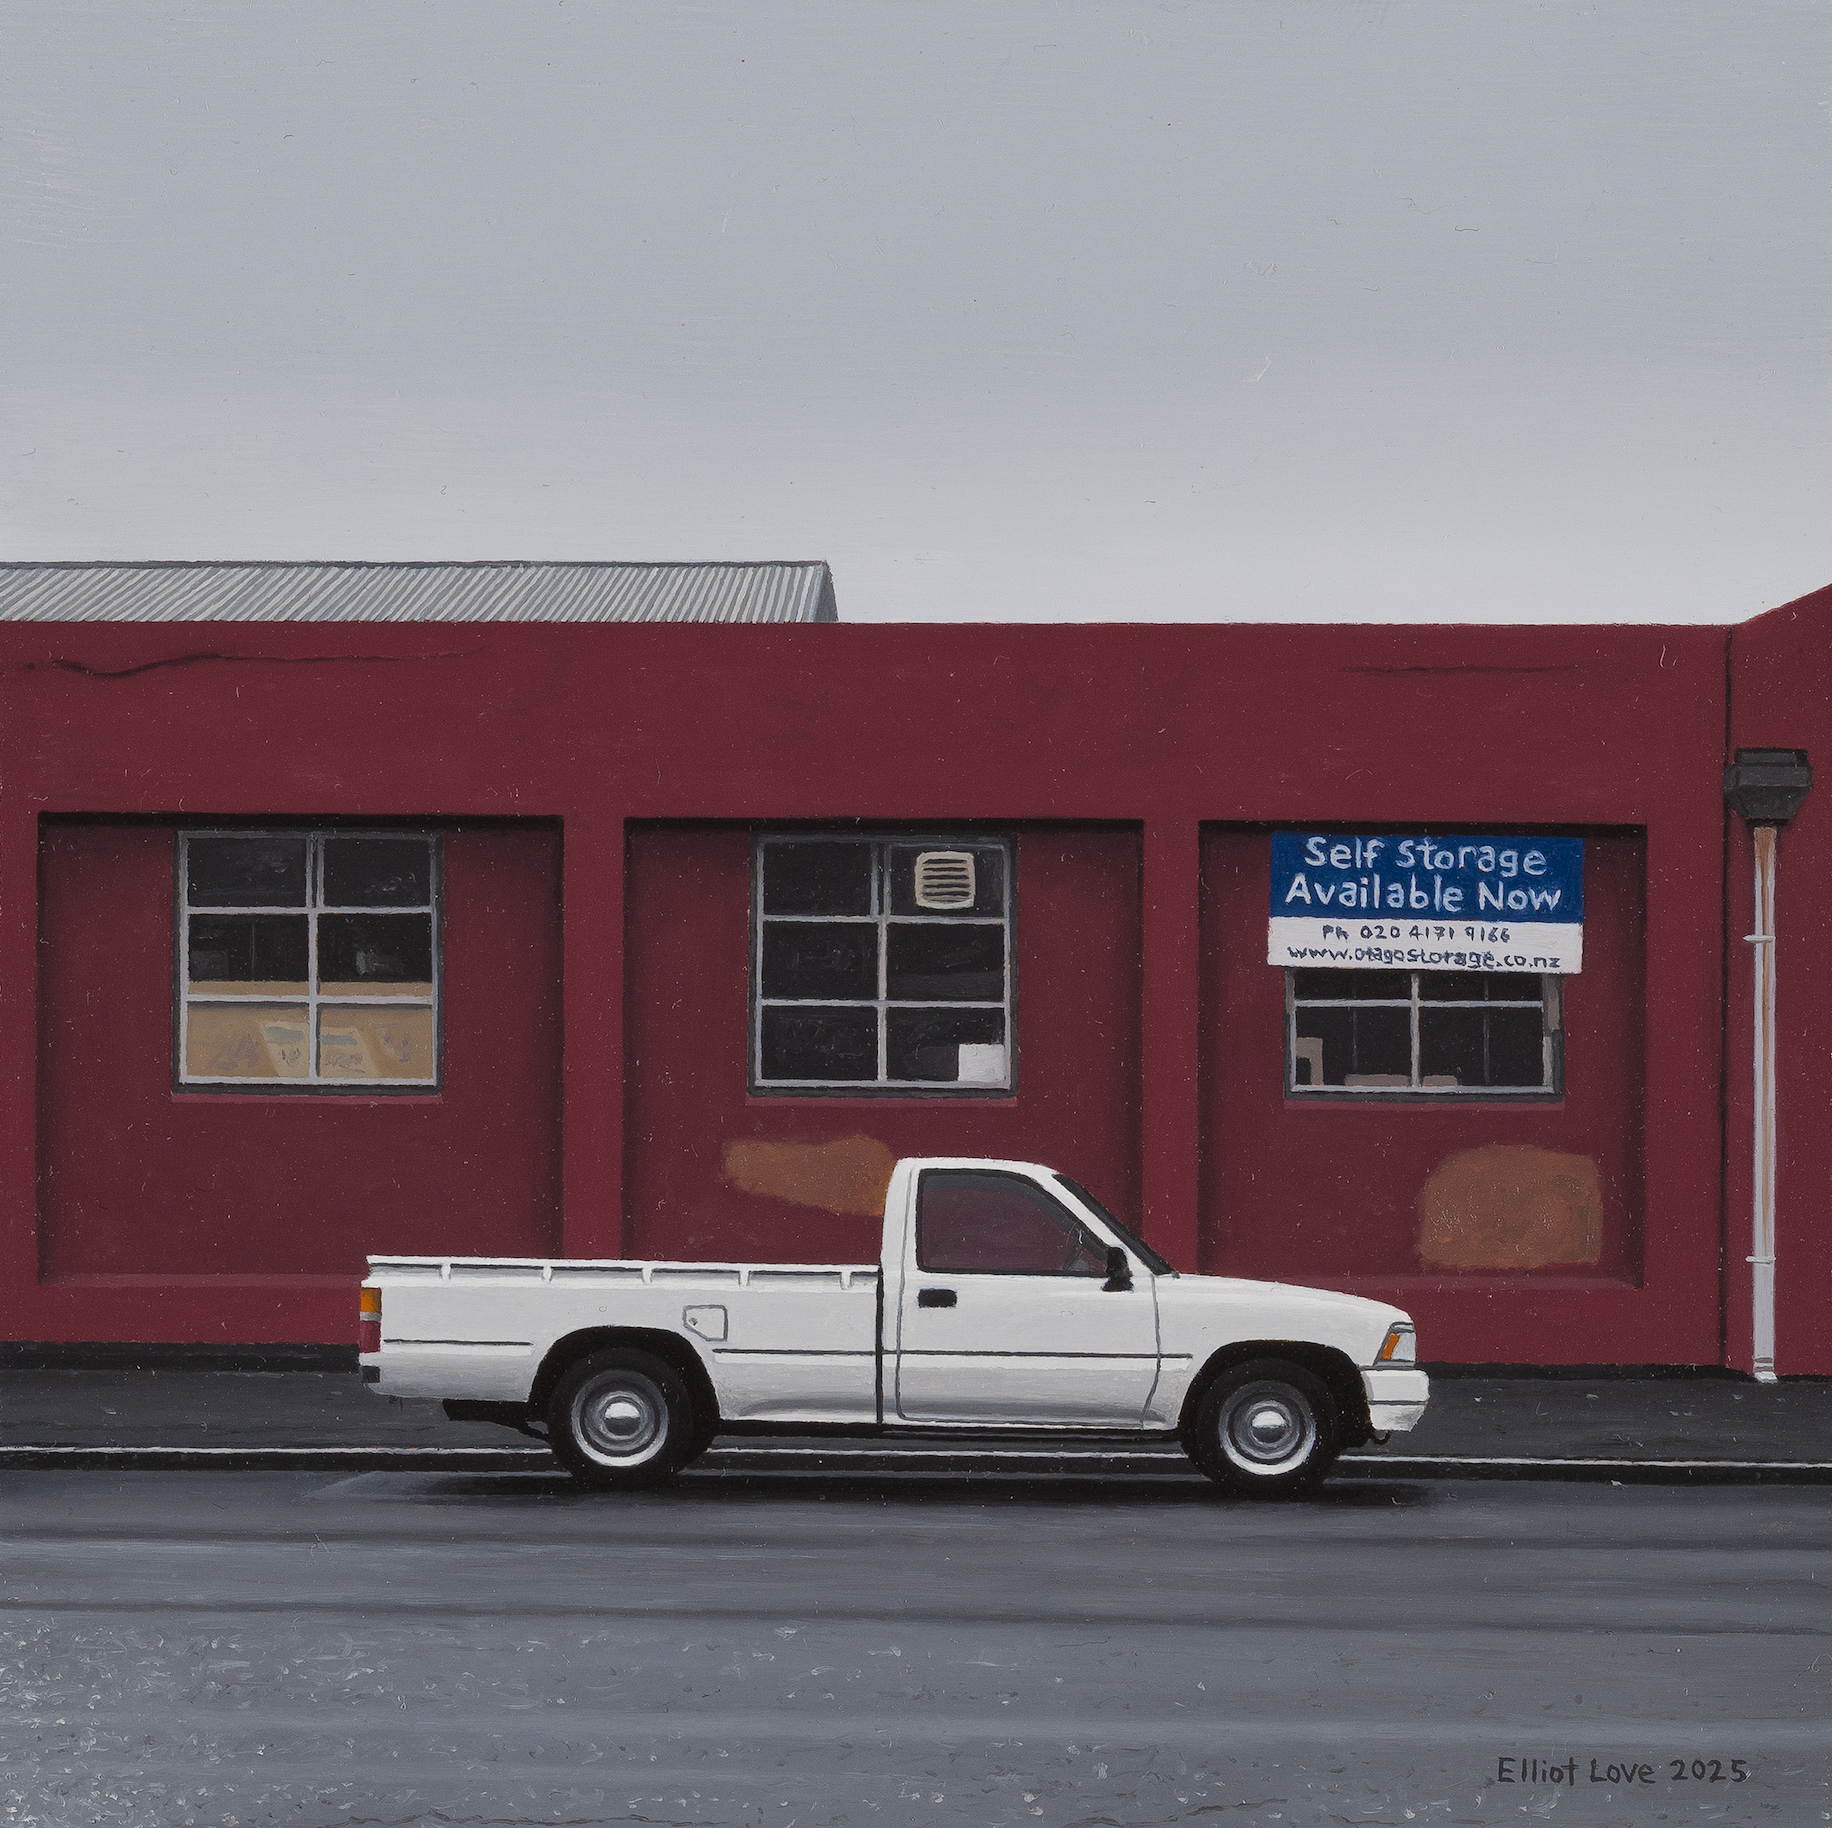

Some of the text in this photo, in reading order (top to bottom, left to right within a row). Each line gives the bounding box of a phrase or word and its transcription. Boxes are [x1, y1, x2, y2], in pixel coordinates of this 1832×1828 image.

[1304, 836, 1386, 869] Self
[1285, 873, 1562, 912] Available Now
[1360, 924, 1401, 940] 020
[1408, 924, 1455, 941] 4171
[1464, 924, 1511, 943] 9166
[1497, 1756, 1748, 1787] Elliot Love 2025
